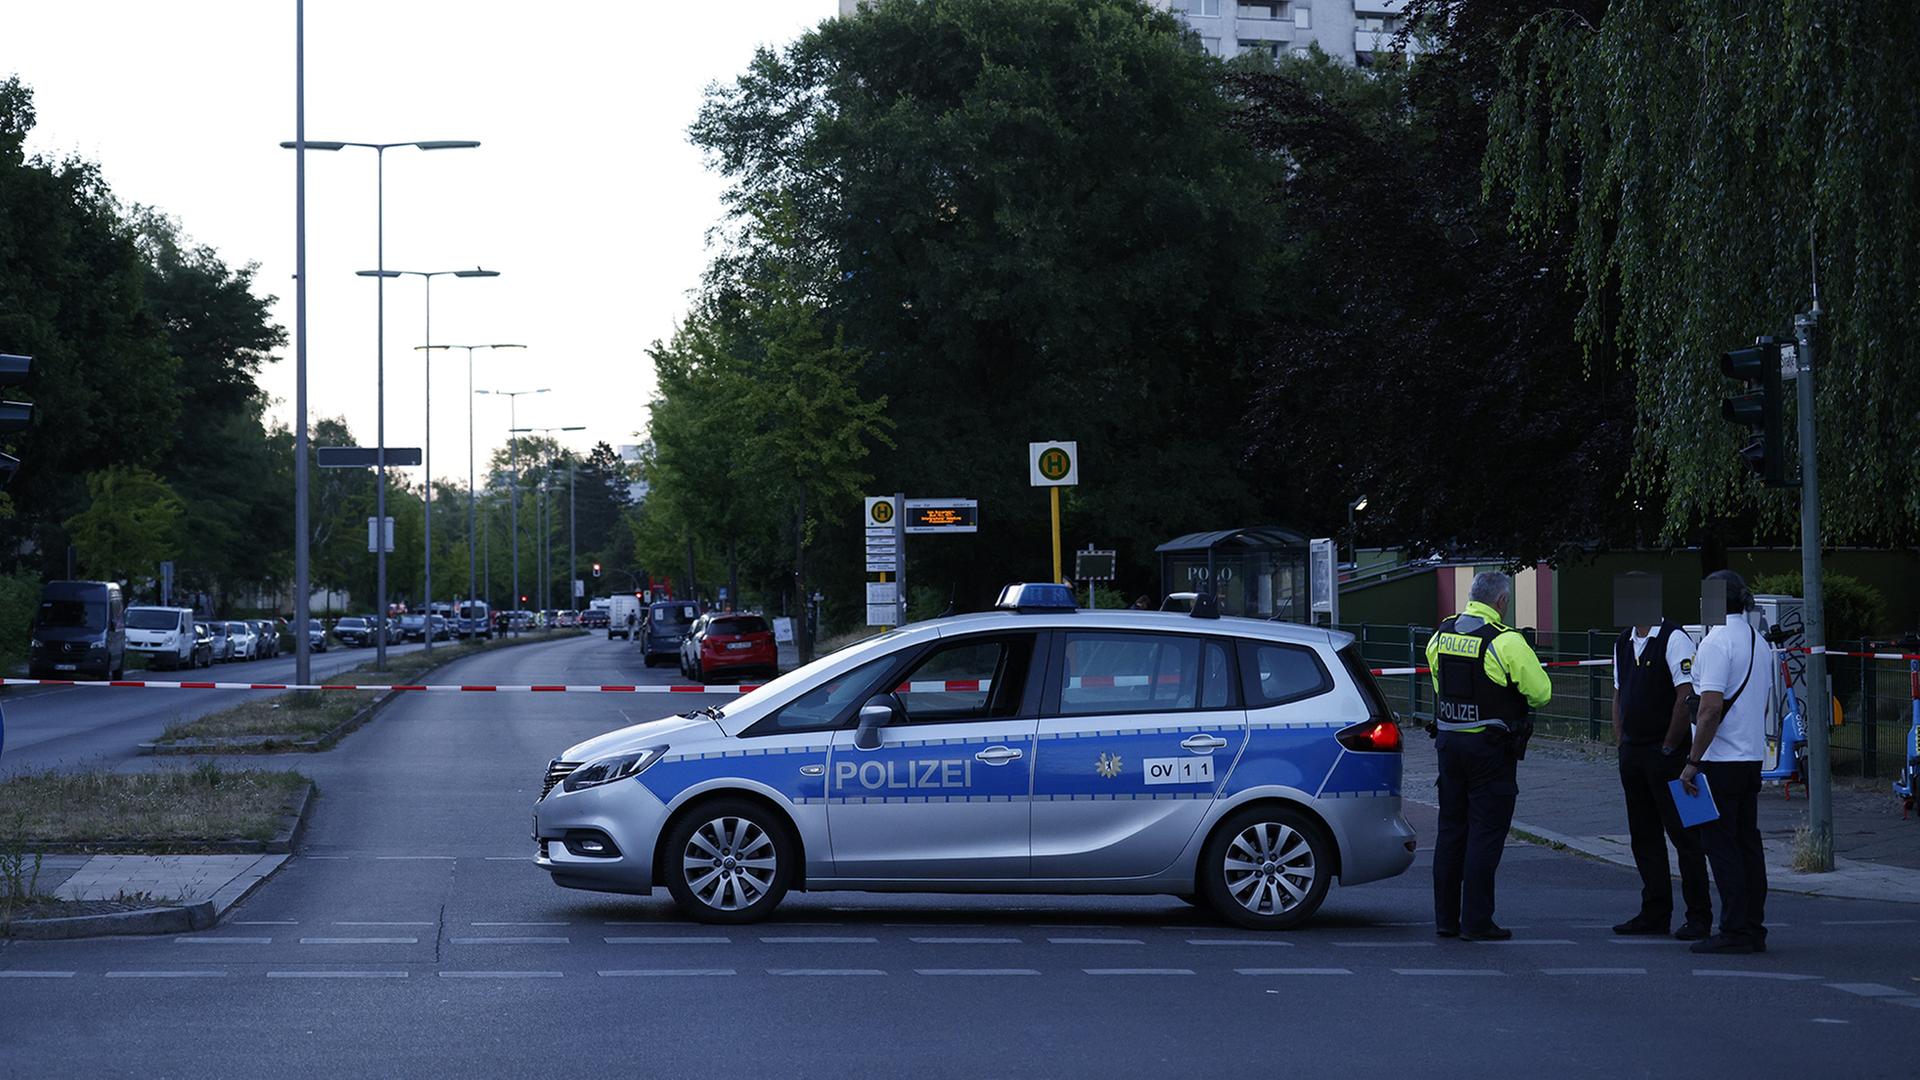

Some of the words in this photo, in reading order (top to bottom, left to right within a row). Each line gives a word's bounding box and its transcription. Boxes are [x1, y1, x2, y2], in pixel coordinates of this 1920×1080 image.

[1048, 455, 1062, 473] H
[878, 505, 888, 519] H
[1440, 636, 1479, 654] POLIZEI
[1440, 701, 1479, 721] POLIZEI
[836, 759, 972, 789] POLIZEI
[1151, 764, 1173, 777] OV
